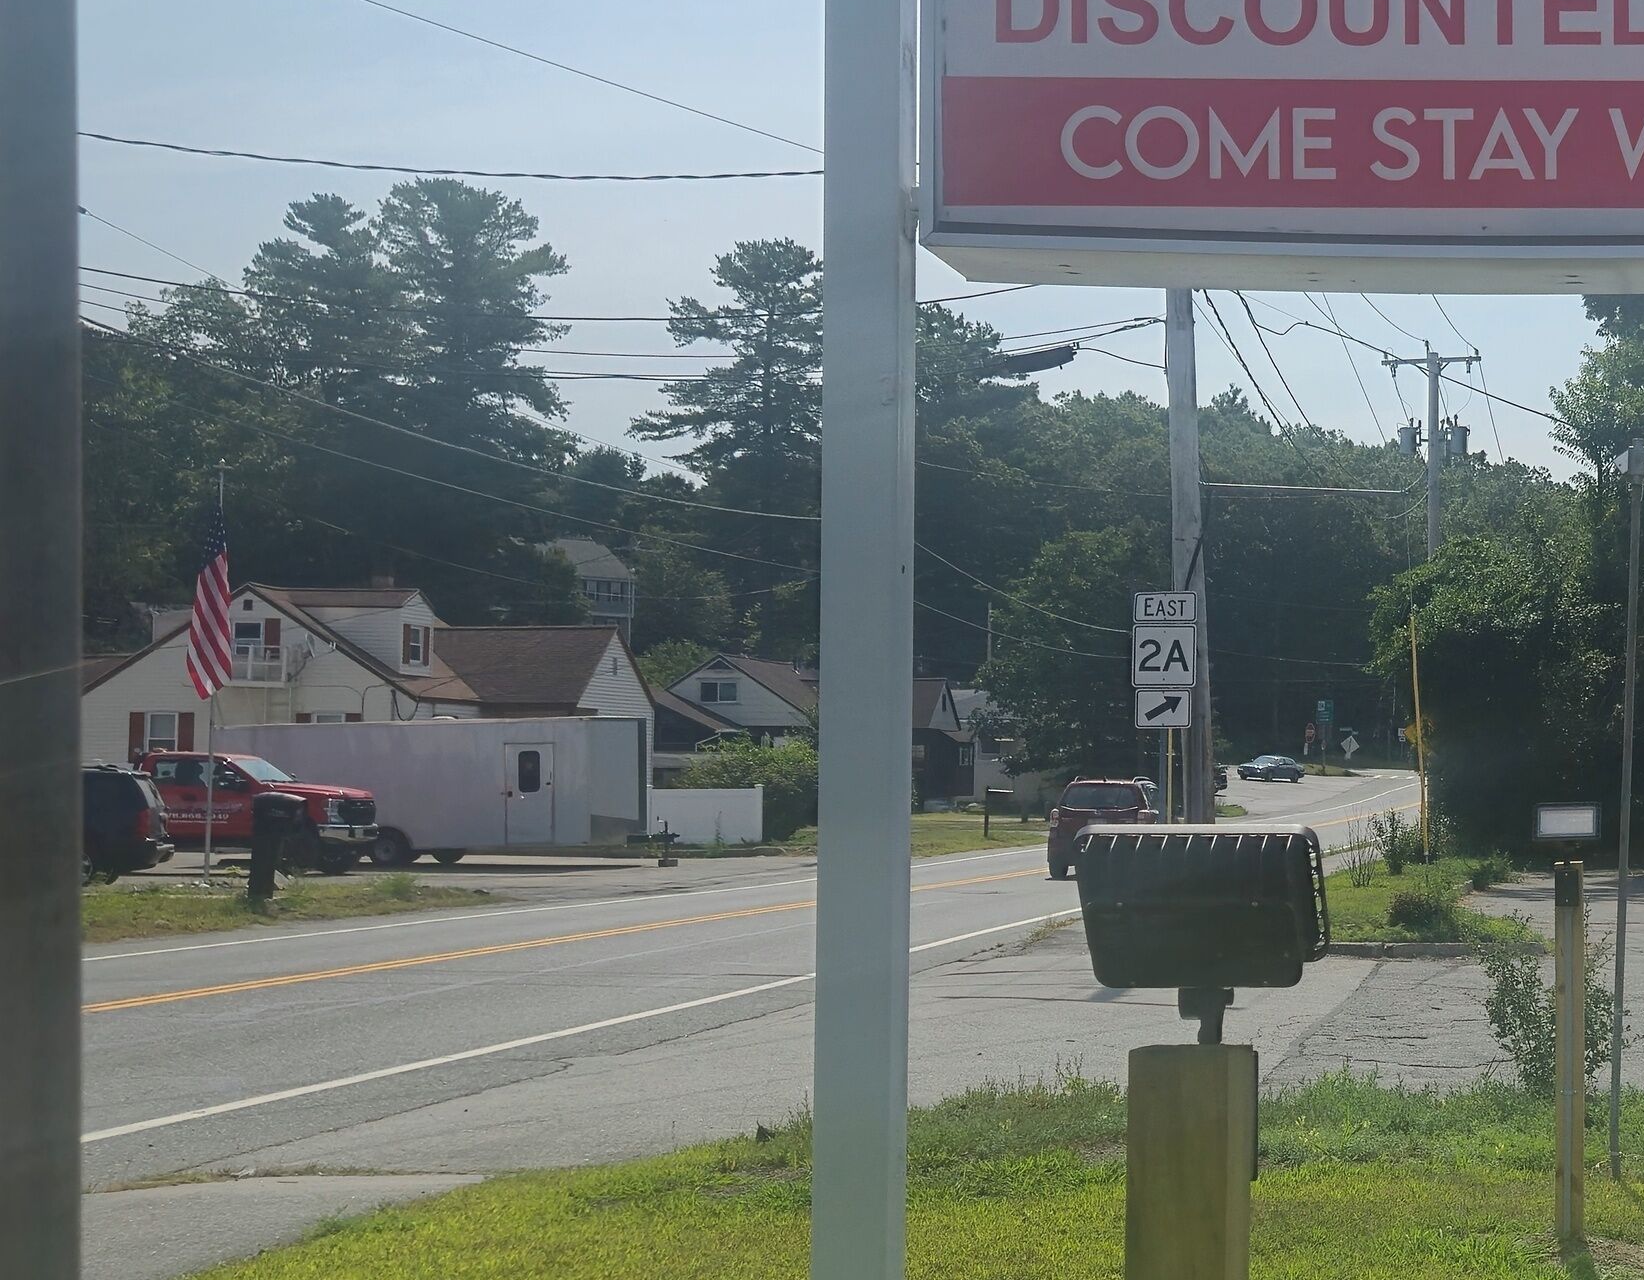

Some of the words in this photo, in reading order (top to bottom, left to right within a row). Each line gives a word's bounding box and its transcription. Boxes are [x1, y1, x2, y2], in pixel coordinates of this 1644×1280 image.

[1060, 105, 1337, 180] COME
[1369, 106, 1580, 181] STAY
[1144, 597, 1187, 617] EAST
[1138, 638, 1190, 672] 2A
